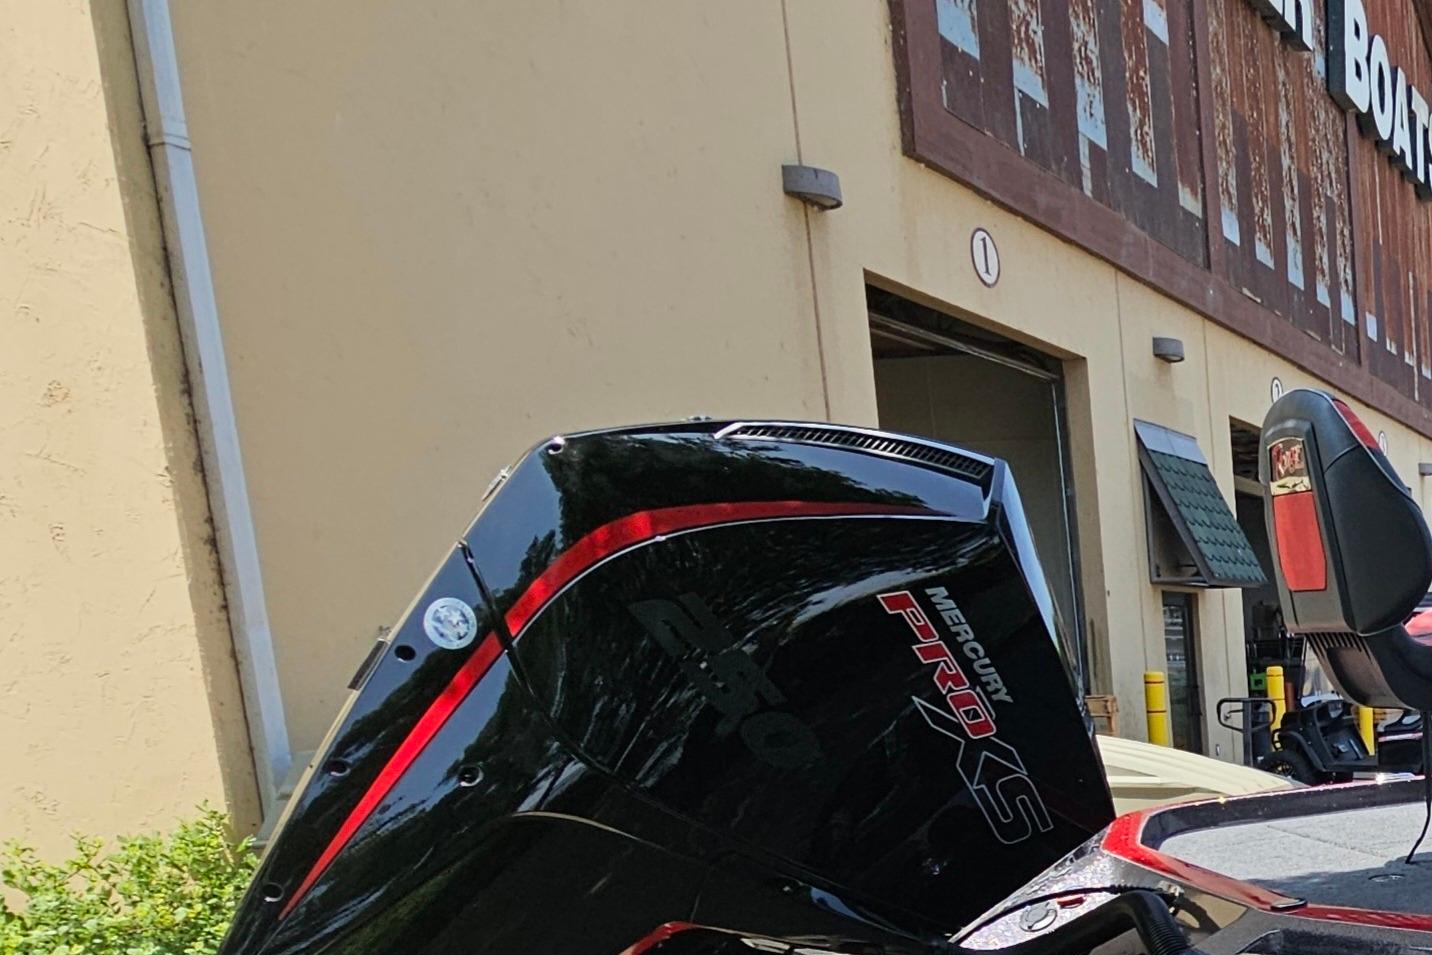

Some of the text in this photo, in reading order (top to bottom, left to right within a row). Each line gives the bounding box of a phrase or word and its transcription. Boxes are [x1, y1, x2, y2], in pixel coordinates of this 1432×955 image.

[979, 236, 991, 276] 1
[877, 590, 997, 739] PRO
[925, 586, 1013, 703] MERCURY
